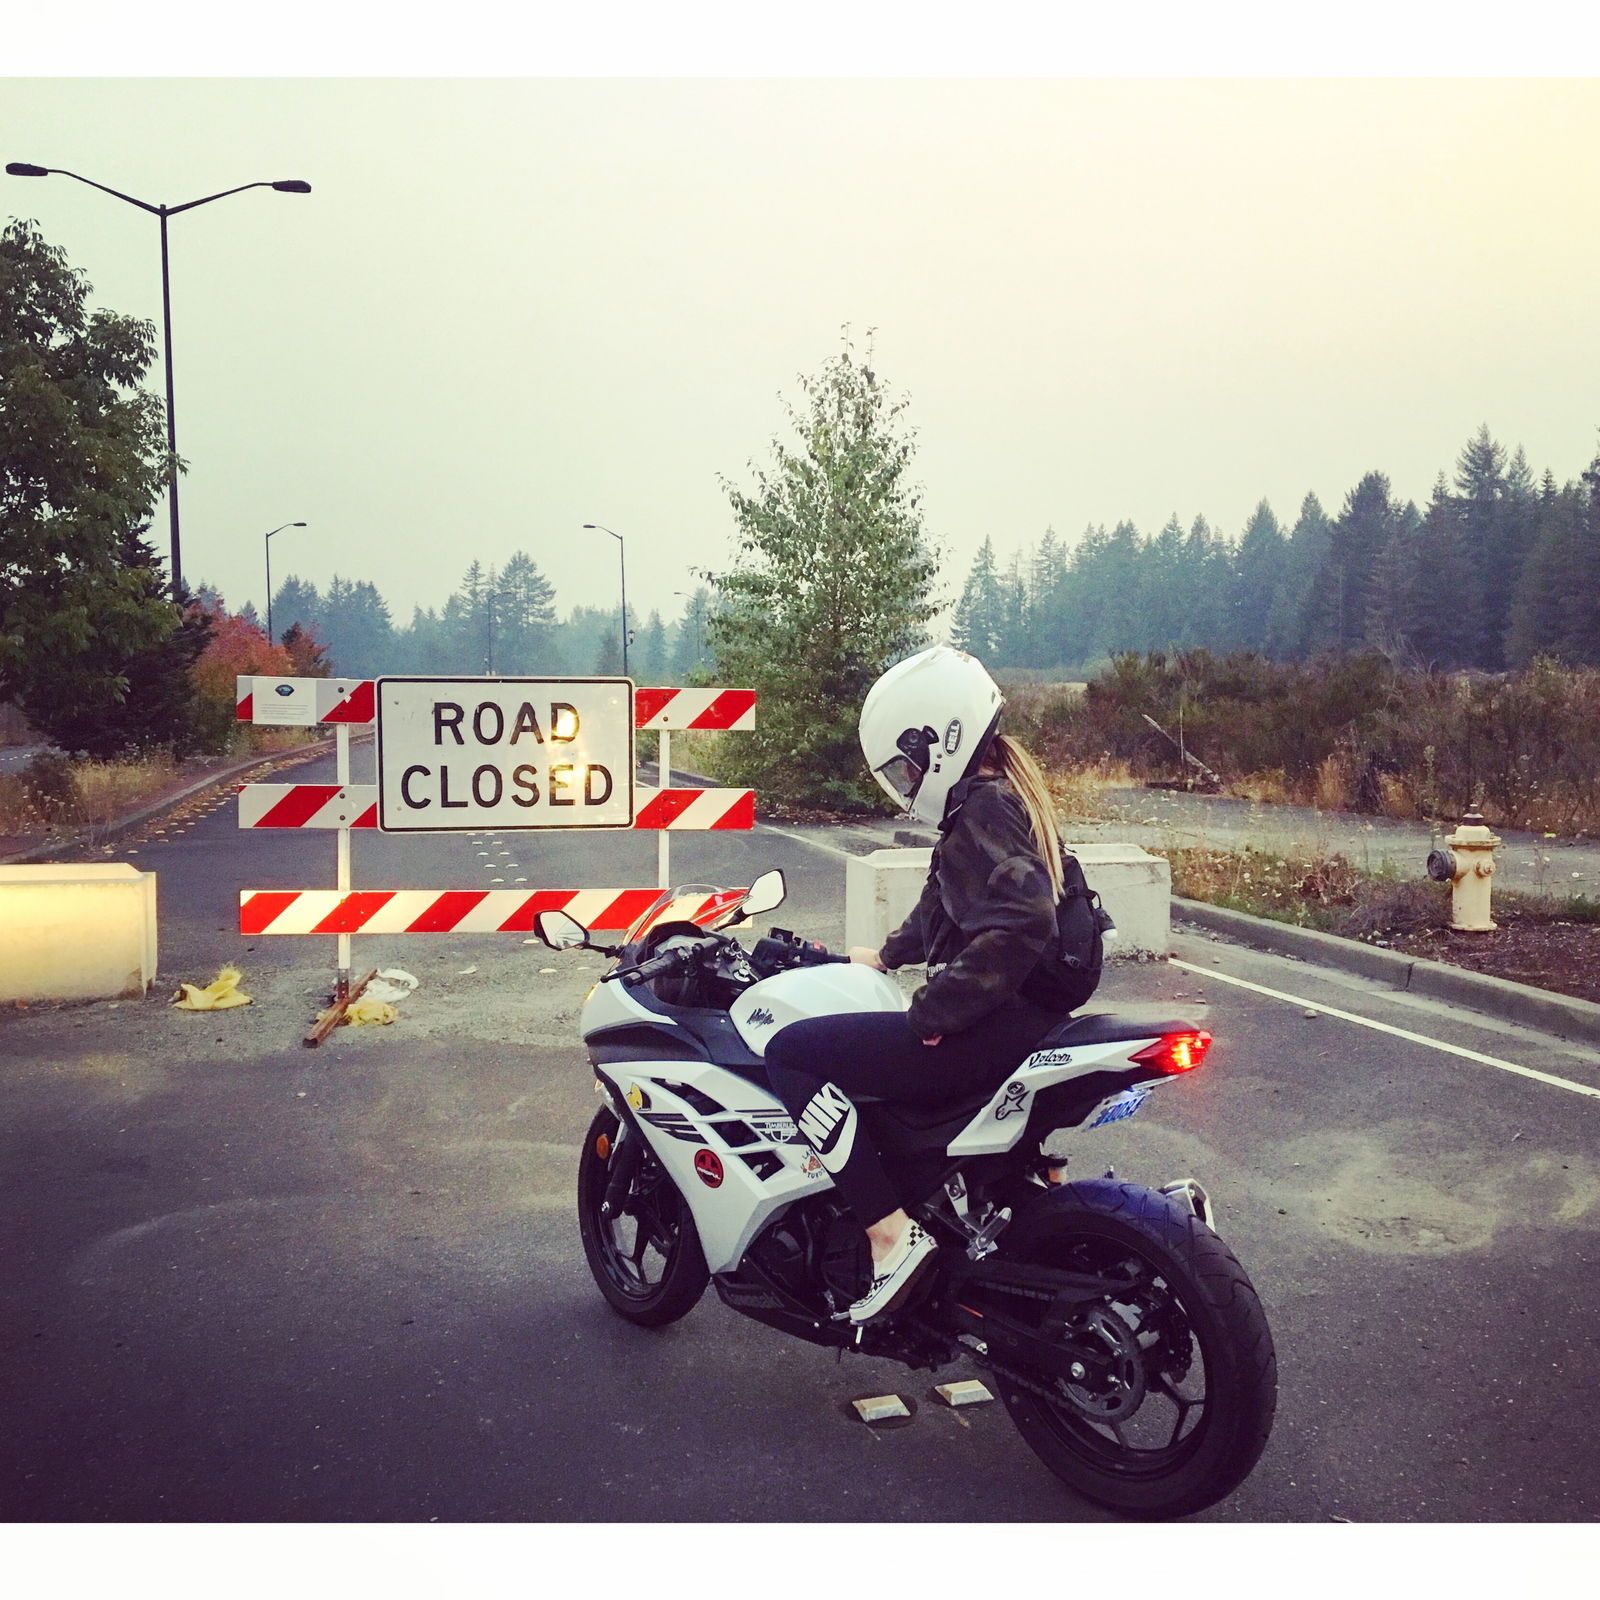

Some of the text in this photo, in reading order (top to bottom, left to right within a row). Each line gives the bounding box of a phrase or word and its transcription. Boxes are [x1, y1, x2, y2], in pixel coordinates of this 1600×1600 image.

[433, 701, 580, 745] ROAD
[946, 723, 960, 751] BELL
[401, 764, 613, 809] CLOSED
[1029, 1049, 1072, 1069] Volcom
[798, 1082, 850, 1151] NIK
